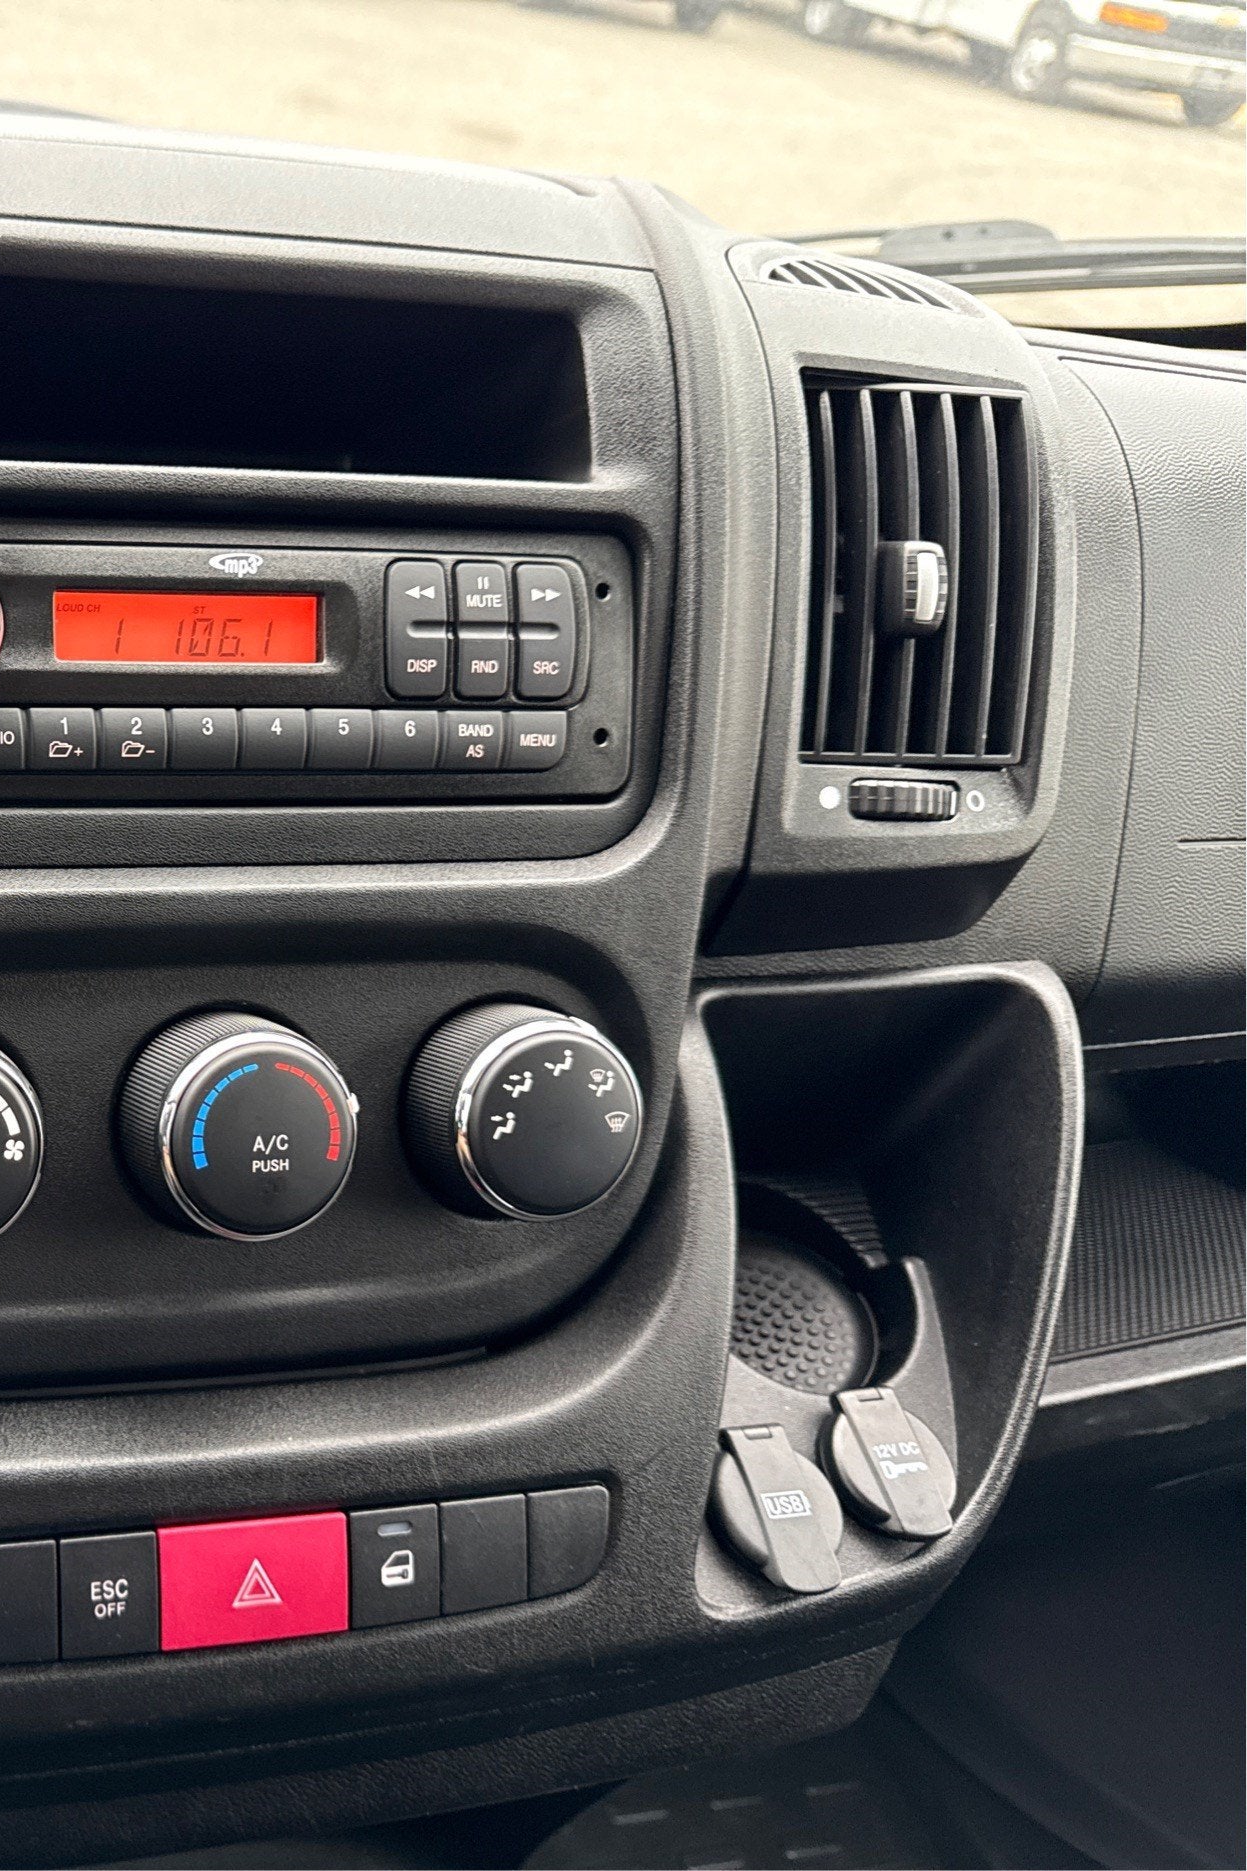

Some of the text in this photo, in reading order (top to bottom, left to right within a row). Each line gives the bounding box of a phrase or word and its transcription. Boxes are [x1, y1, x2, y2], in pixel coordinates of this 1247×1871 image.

[220, 553, 260, 577] mp3
[56, 603, 101, 613] LOUD CH
[466, 594, 502, 608] MUTE
[193, 606, 206, 614] ST
[175, 618, 273, 657] 106.1
[407, 659, 437, 673] DISP
[471, 660, 499, 674] RND
[533, 661, 559, 675] SRC
[60, 717, 68, 735] 1
[131, 717, 143, 735] 2
[202, 718, 214, 736] 3
[271, 718, 282, 735] 4
[338, 718, 349, 735] 5
[404, 720, 416, 737] 6
[458, 723, 494, 738] BAND
[520, 733, 556, 747] MENU
[466, 744, 484, 758] AS
[252, 1134, 289, 1155] A/C
[252, 1158, 290, 1173] PUSH
[873, 1441, 921, 1460] 12V DC
[770, 1496, 805, 1516] USB
[90, 1578, 129, 1601] ESC
[94, 1601, 126, 1619] OFF
